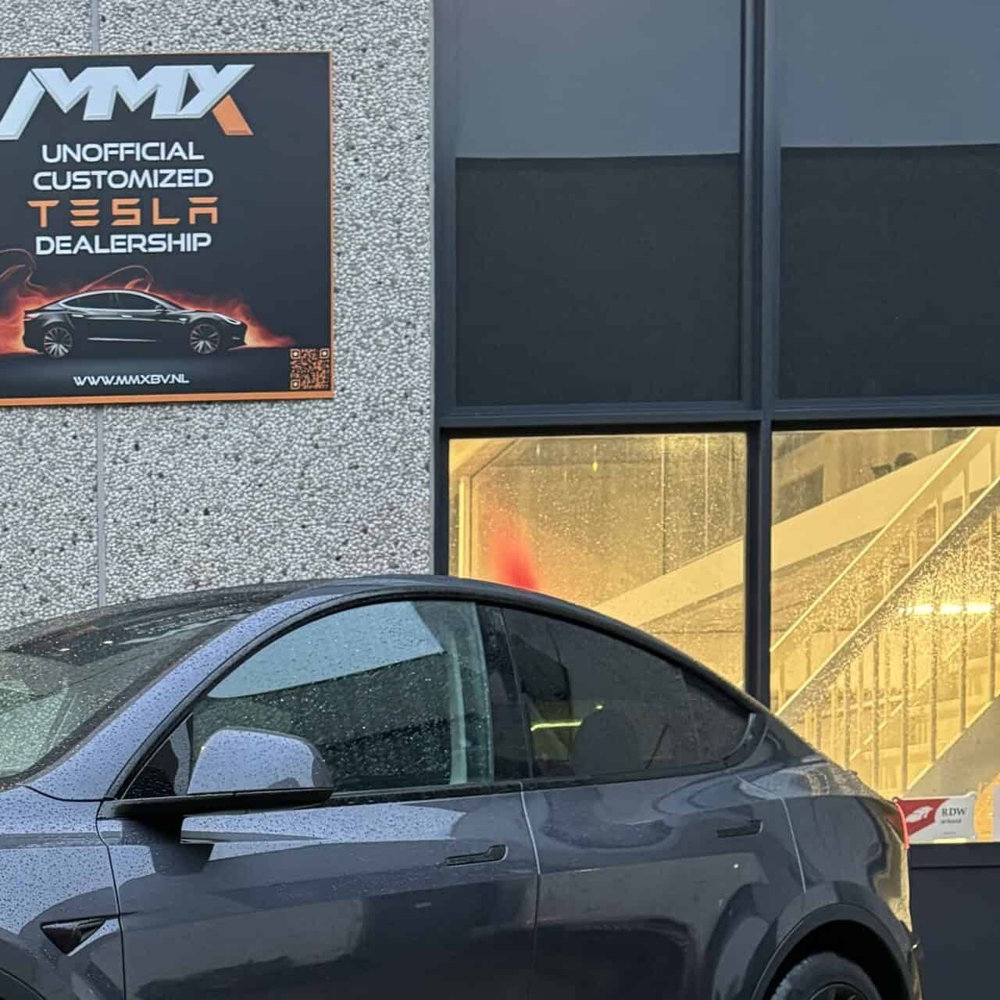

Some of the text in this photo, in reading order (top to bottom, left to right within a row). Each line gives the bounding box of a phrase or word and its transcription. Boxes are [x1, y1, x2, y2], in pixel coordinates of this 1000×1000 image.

[42, 142, 204, 163] UNOFFICIAL
[33, 168, 214, 191] CUSTOMIZED
[27, 197, 218, 228] TESLA
[35, 233, 212, 256] DEALERSHIP
[73, 374, 190, 386] WWW.MMXBV.NL
[941, 807, 968, 817] RDW
